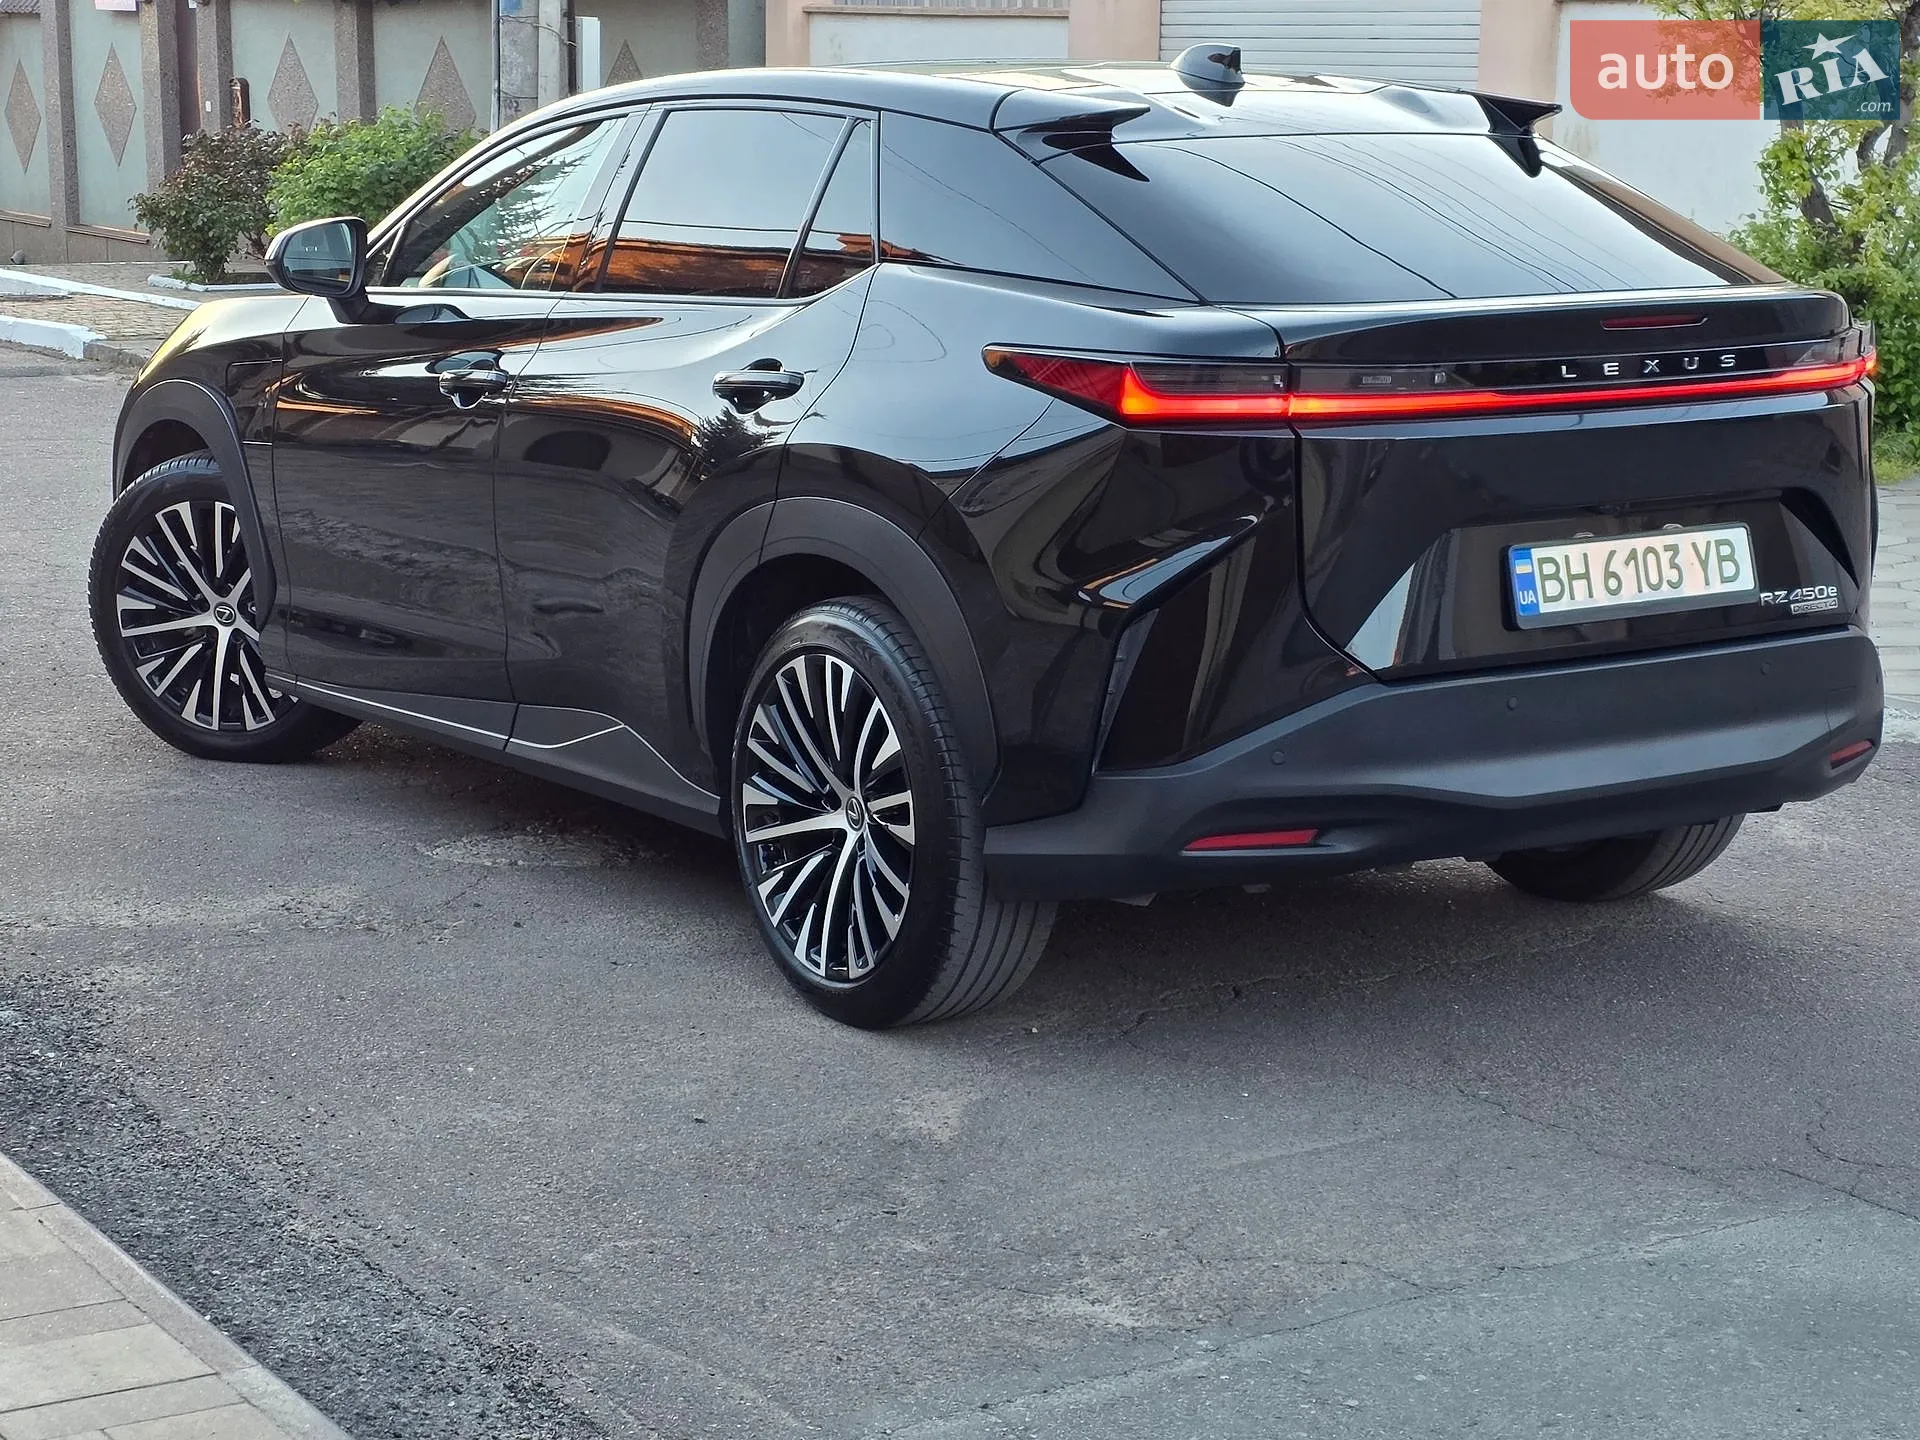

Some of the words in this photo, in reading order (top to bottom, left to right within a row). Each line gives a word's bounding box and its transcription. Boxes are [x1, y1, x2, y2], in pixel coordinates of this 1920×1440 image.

[1561, 354, 1736, 378] LEXUS
[1537, 552, 1594, 604] BH
[1603, 543, 1684, 596] 6103
[1691, 538, 1740, 586] YB
[1519, 589, 1537, 605] UA
